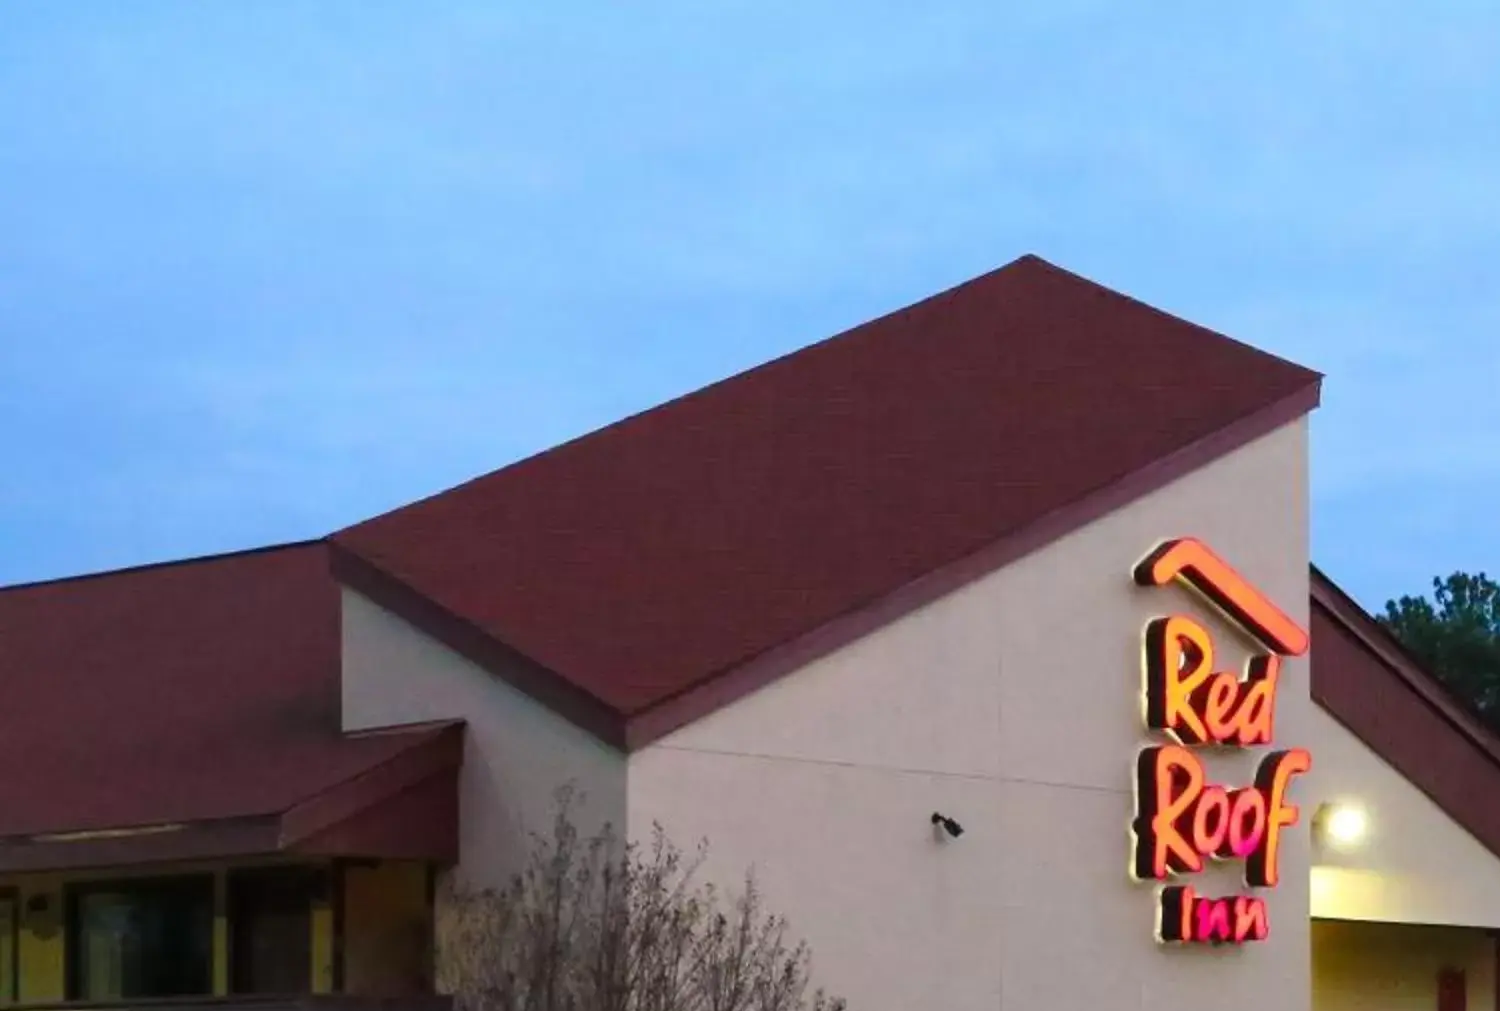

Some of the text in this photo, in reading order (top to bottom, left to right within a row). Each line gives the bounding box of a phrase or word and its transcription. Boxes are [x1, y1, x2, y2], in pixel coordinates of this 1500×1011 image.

[1149, 615, 1281, 746] Red
[1139, 745, 1312, 887] Roof
[1166, 886, 1270, 941] Inn
